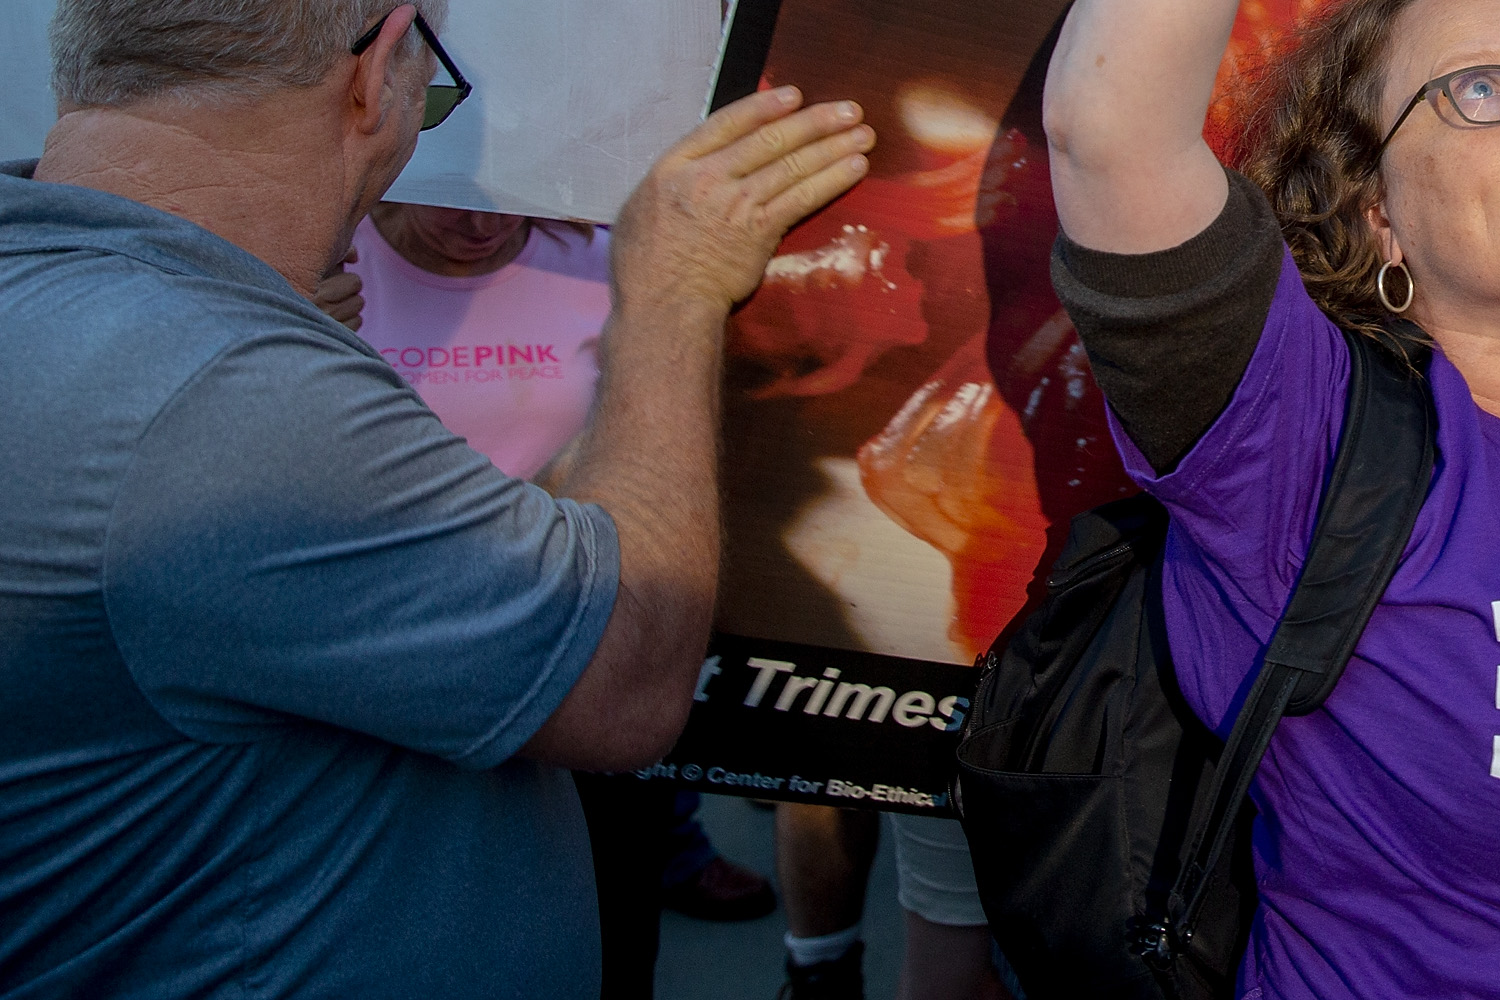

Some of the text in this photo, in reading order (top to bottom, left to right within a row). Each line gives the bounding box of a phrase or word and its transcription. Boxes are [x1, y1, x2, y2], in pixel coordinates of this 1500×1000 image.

[380, 344, 560, 368] CODEPINK
[400, 371, 459, 384] OMEN
[465, 370, 503, 383] FOR
[744, 656, 970, 731] Trimes
[707, 766, 785, 790] Center
[789, 775, 824, 794] for
